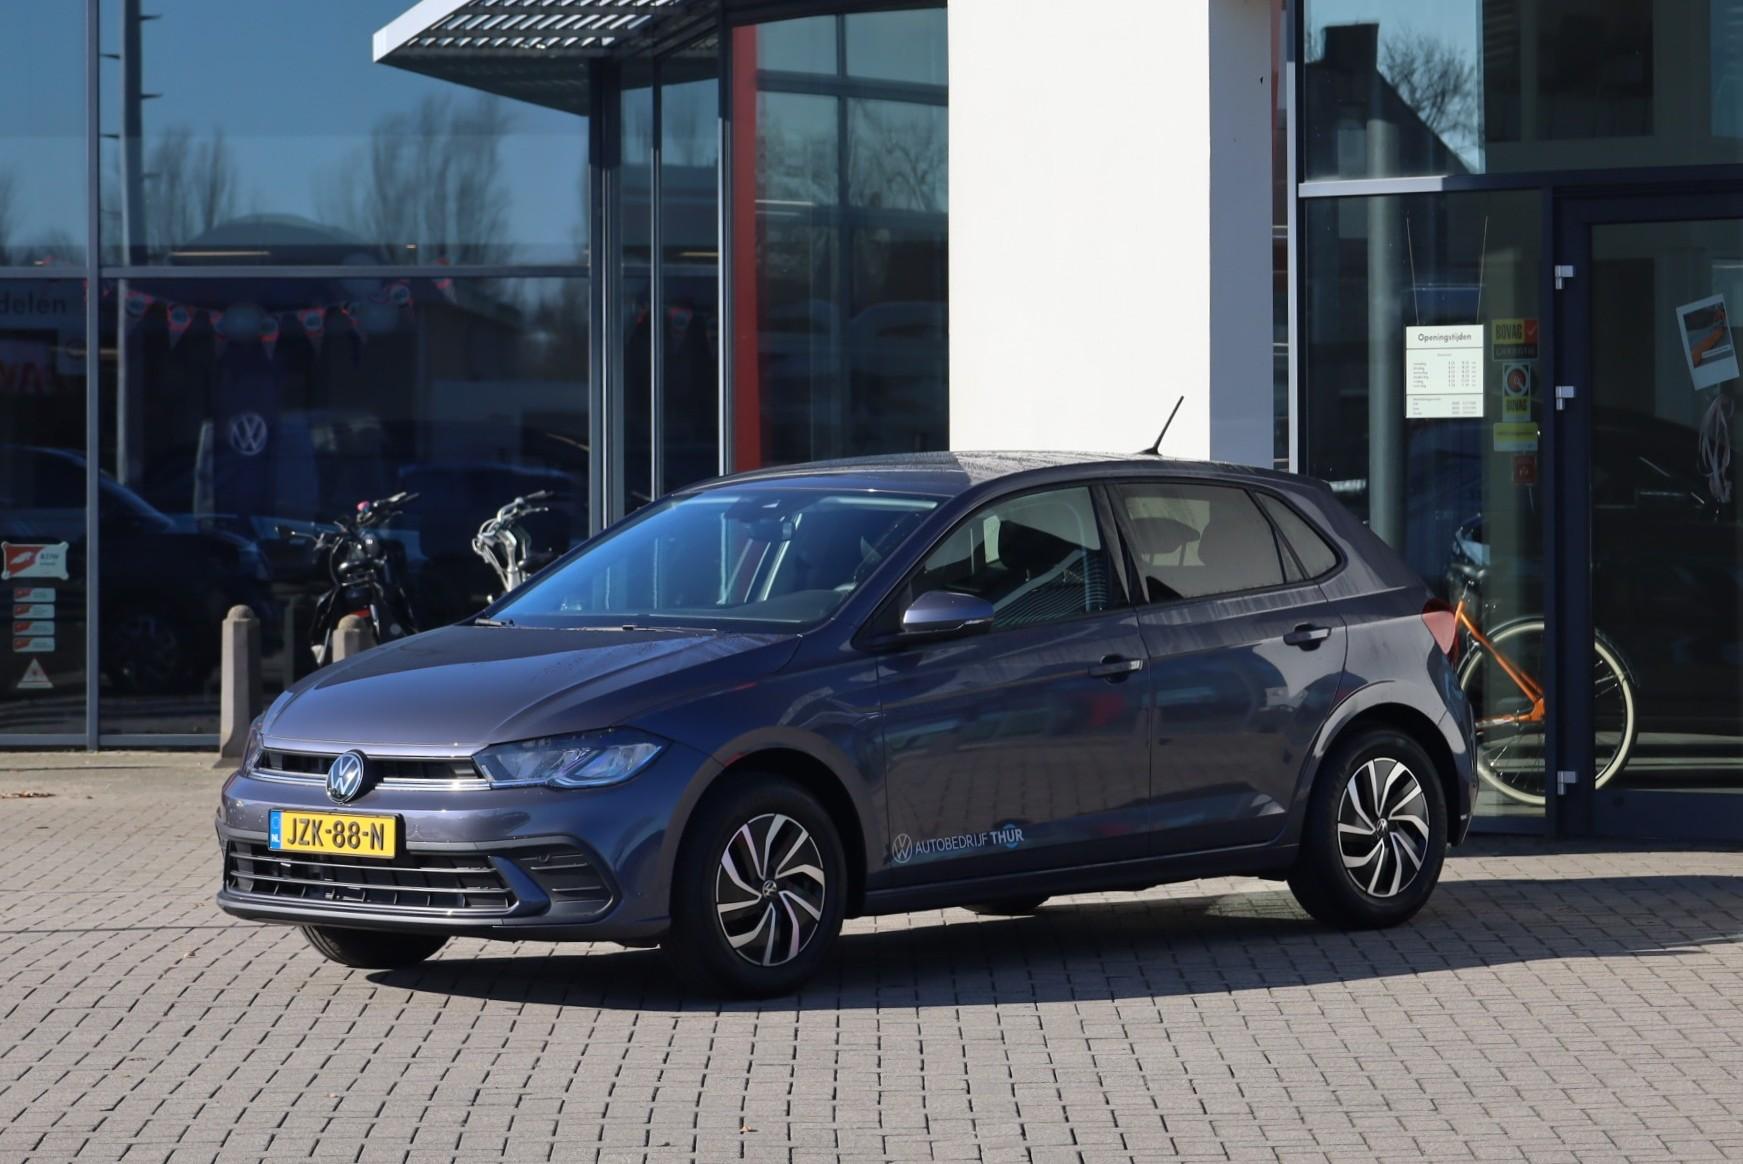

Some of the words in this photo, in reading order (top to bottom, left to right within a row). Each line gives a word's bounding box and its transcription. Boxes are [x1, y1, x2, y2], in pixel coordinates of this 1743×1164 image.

[1417, 332, 1472, 343] Openingstijden
[1496, 324, 1522, 340] BOVAG
[271, 834, 280, 842] NL
[287, 817, 385, 851] JZK-88-N
[915, 832, 988, 855] AUTOBEDRIJF
[989, 828, 1024, 846] THUR
